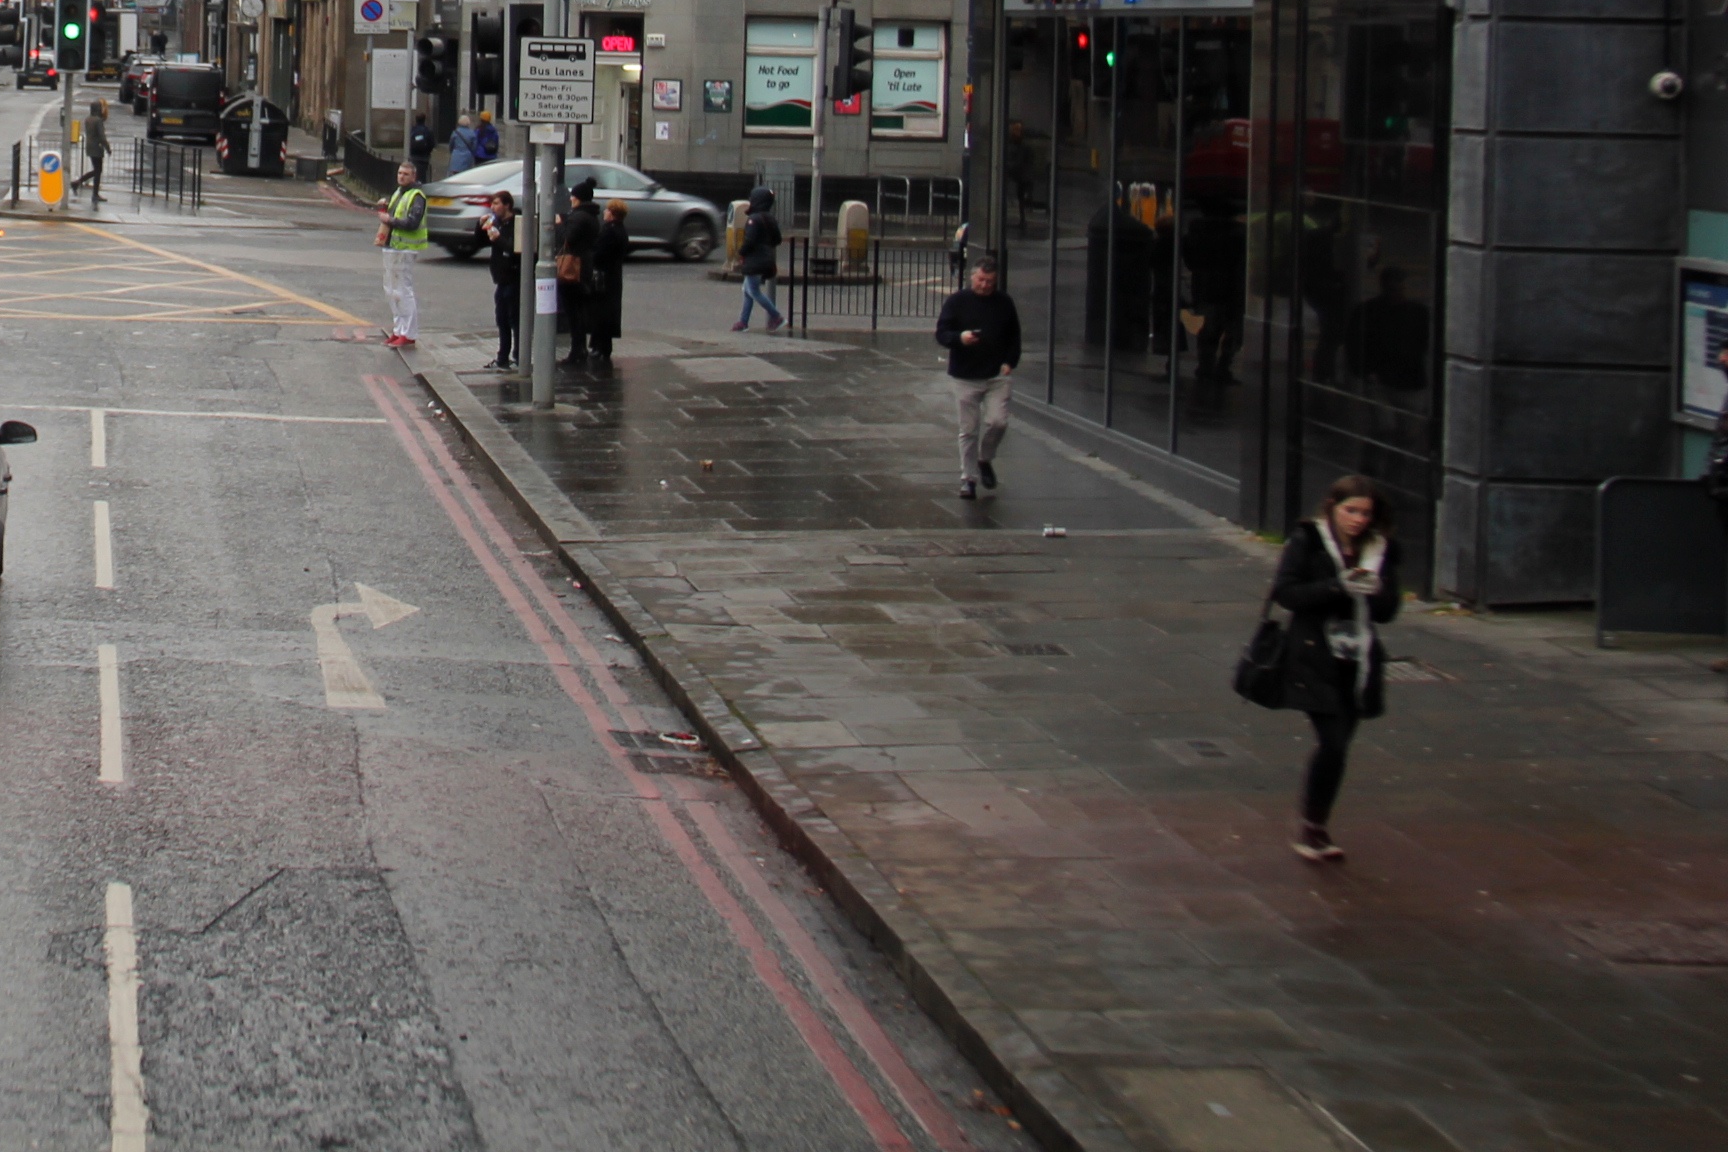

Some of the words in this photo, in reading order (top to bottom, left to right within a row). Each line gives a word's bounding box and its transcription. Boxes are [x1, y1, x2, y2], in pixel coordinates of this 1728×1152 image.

[602, 36, 635, 52] OPEN
[529, 66, 550, 76] Bus
[555, 67, 584, 77] lanes
[758, 65, 775, 76] Hot
[777, 66, 799, 76] Food
[893, 68, 916, 80] Open
[766, 79, 777, 88] to
[778, 81, 790, 91] go
[902, 81, 922, 92] Late
[538, 102, 574, 111] Saturday
